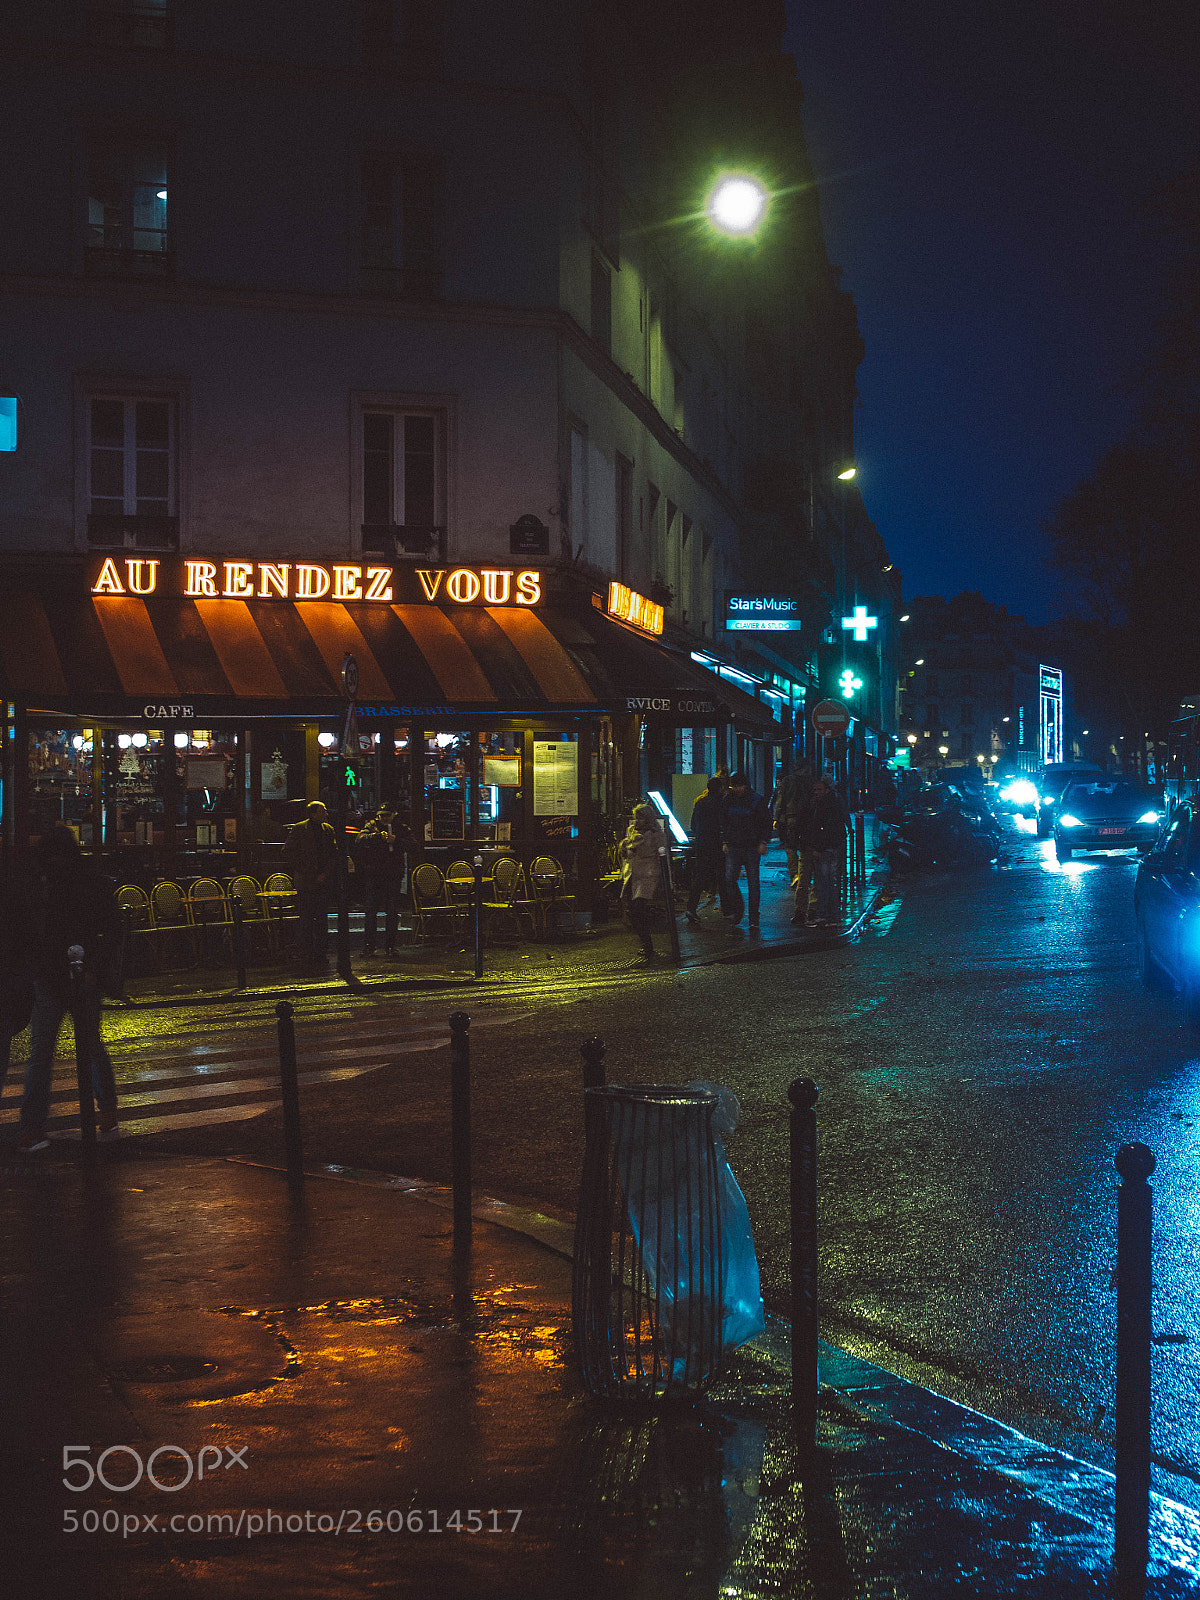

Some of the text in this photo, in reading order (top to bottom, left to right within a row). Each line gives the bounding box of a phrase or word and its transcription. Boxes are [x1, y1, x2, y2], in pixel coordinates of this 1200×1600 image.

[91, 557, 542, 606] AU RENDEZ VOUS
[143, 704, 194, 719] CAFE
[354, 705, 456, 717] BRASSERIE
